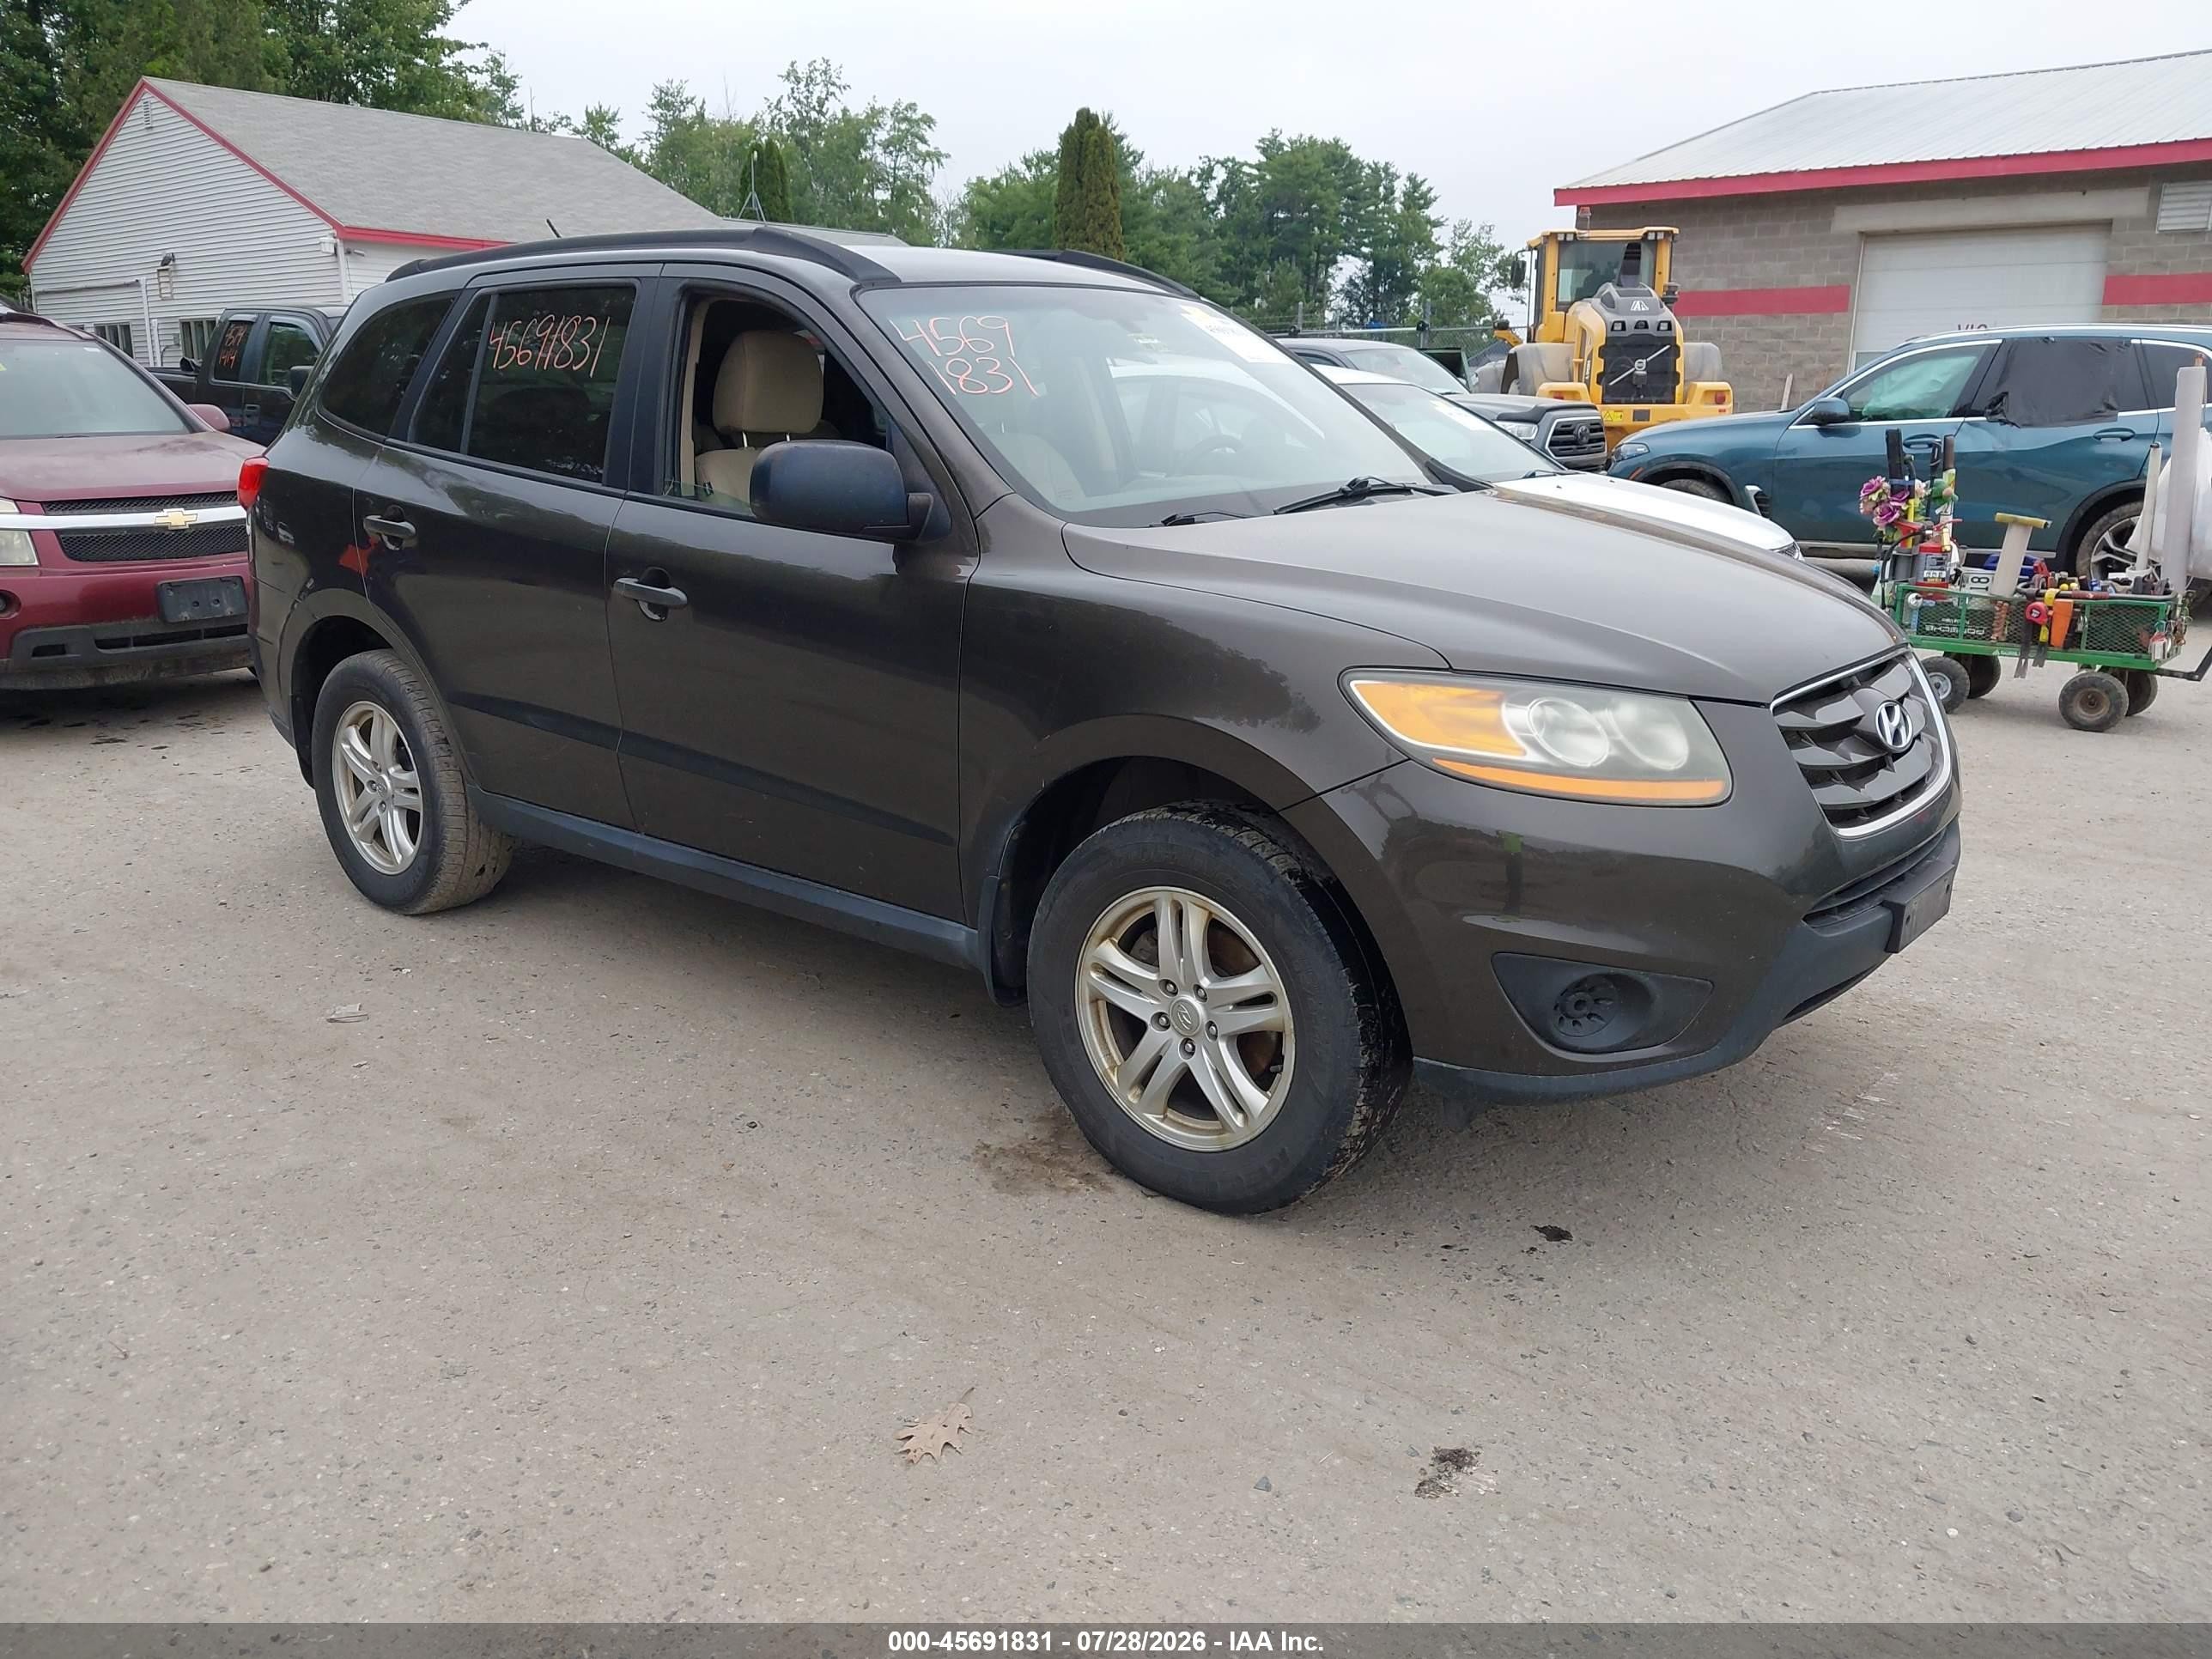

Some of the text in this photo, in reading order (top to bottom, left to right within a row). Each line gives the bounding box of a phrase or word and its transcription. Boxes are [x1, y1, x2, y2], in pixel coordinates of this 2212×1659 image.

[489, 314, 611, 378] 45691831
[887, 315, 1015, 357] 4569
[927, 356, 1039, 396] 1831
